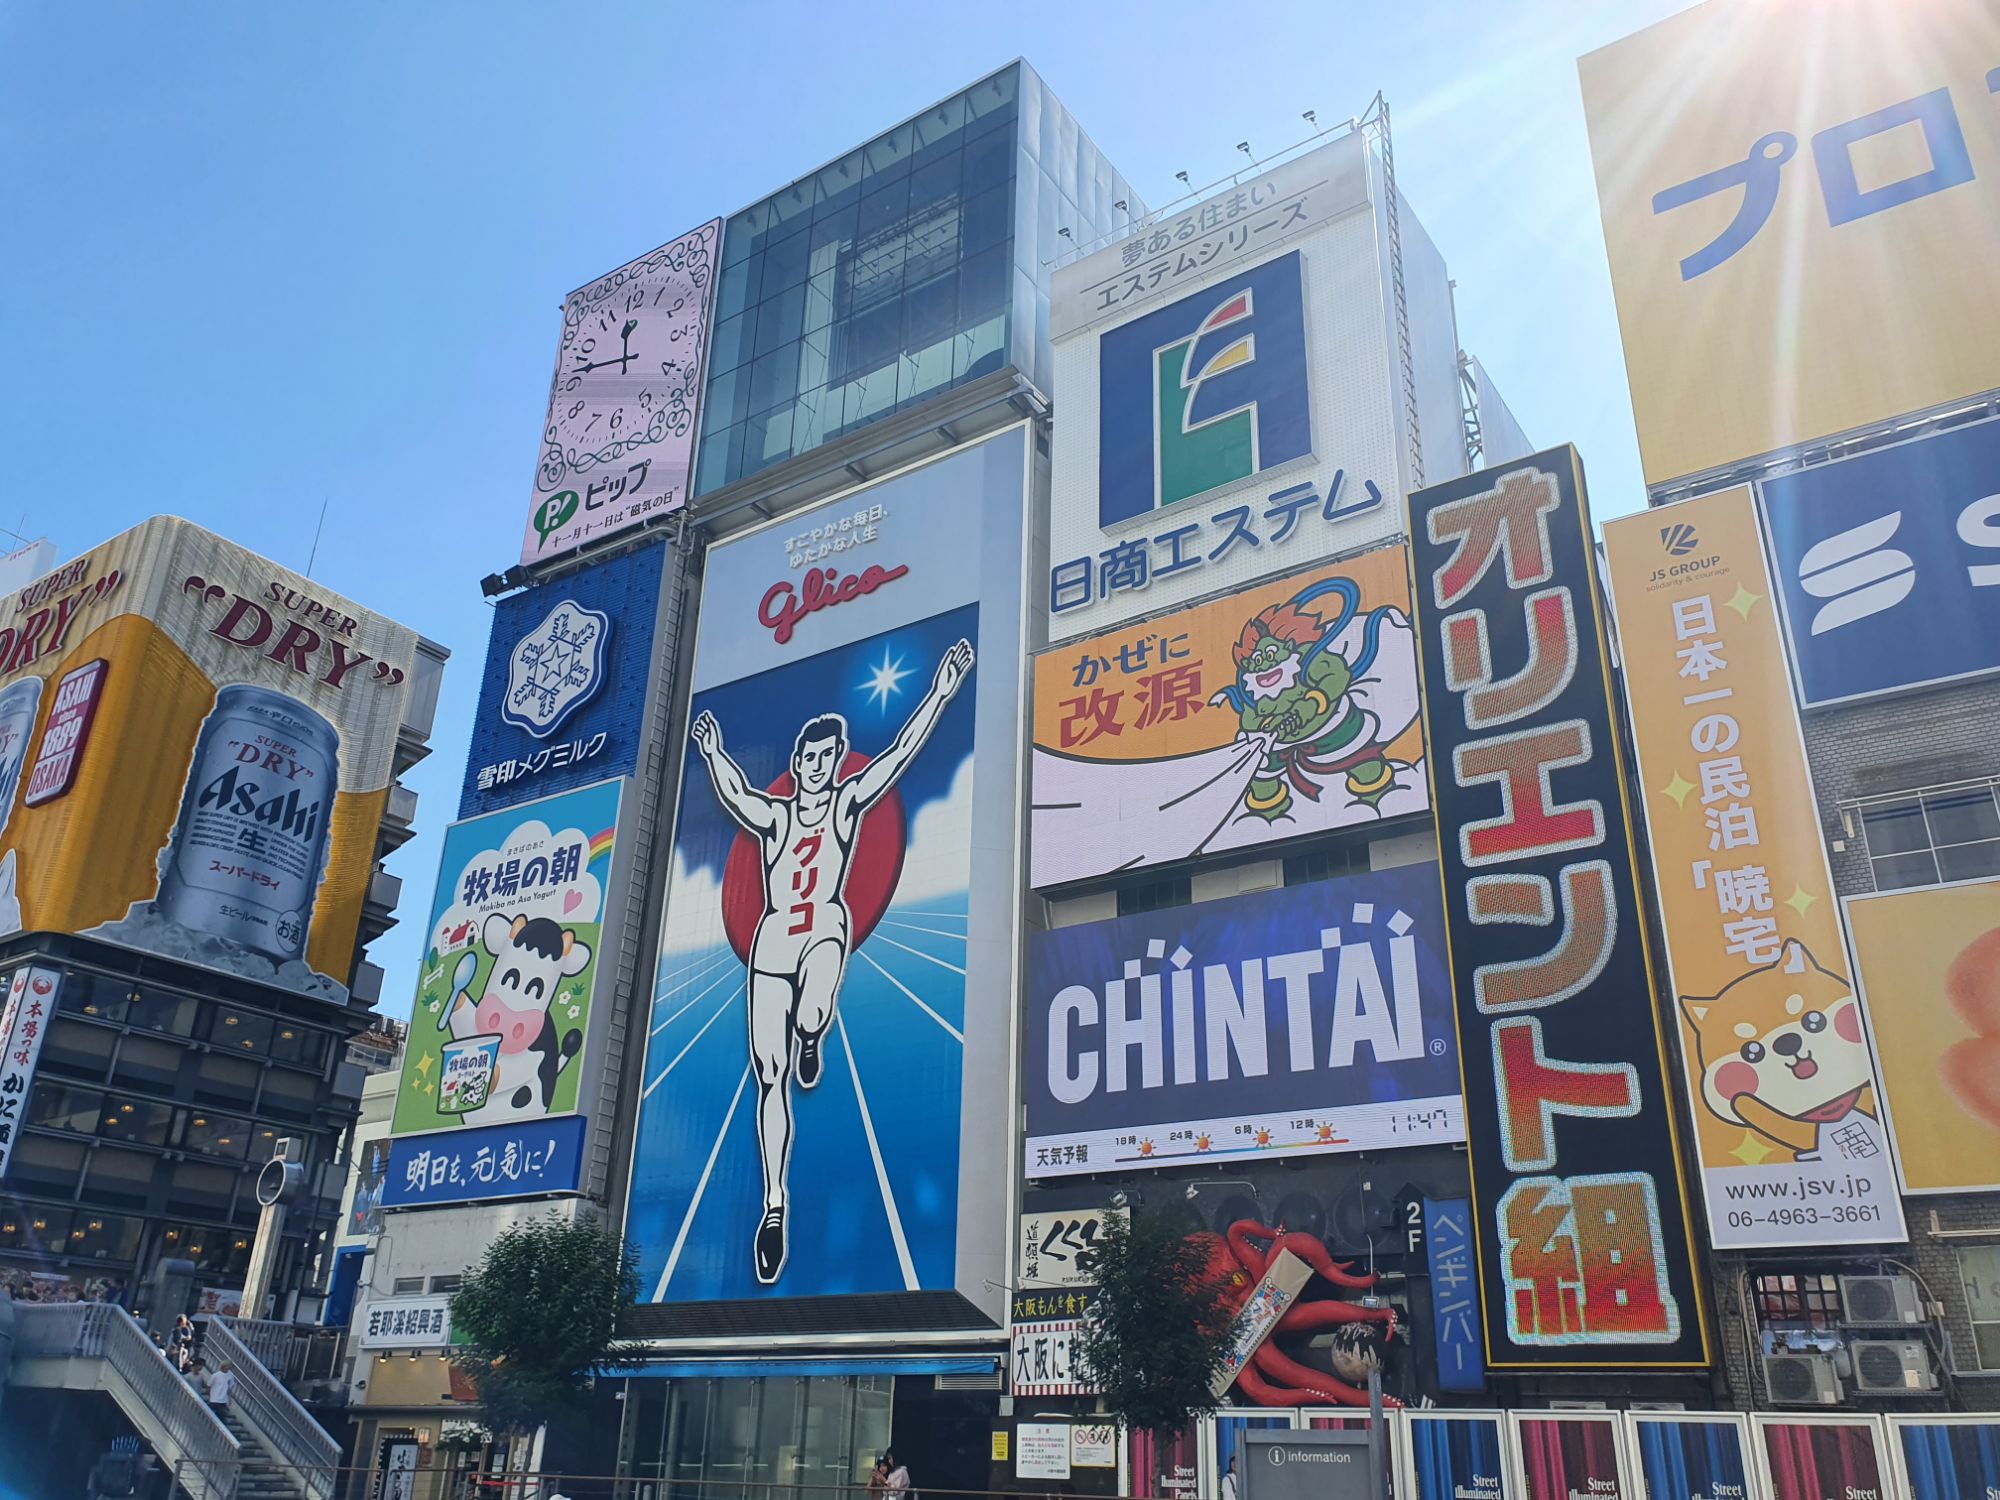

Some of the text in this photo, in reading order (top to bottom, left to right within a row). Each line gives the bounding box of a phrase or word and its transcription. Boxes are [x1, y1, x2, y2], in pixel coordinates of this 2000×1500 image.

[1652, 66, 2000, 281] プロ
[1121, 182, 1277, 268] 夢ある住まい
[1096, 196, 1309, 311] エステムシリーズ
[584, 458, 652, 511] ピップ
[789, 525, 879, 569] ゆたかな人生
[1050, 468, 1383, 615] 日商エステム
[15, 559, 86, 614] SUPER
[1646, 579, 1683, 592] solidarity
[1695, 567, 1730, 580] courage
[1649, 555, 1721, 582] JS GROUP
[264, 582, 358, 637] SUPER
[758, 564, 909, 644] Glico
[1071, 632, 1190, 688] かぜに
[52, 670, 98, 716] ASAHI
[1058, 658, 1209, 749] 改源
[40, 716, 83, 760] 1889
[255, 735, 297, 758] SUPER
[28, 753, 71, 797] OSAKA
[476, 732, 607, 791] 雪印メグミルク
[198, 765, 320, 842] Asahi
[237, 828, 268, 855] 生
[506, 840, 545, 857] まきばのあさ
[209, 860, 280, 890] スーパードライ
[463, 842, 582, 907] 牧場の朝
[787, 827, 825, 936] グリコ
[478, 888, 557, 914] Makiba no Asa Yogurt
[1426, 466, 1681, 1346] オリエント組
[449, 1053, 489, 1072] 牧場の朝
[1115, 1135, 1137, 1146] 18時
[1169, 1130, 1193, 1141] 24時
[1234, 1124, 1253, 1135] 6時
[1290, 1118, 1314, 1129] 12時
[1036, 1144, 1088, 1167] 天気予報
[1725, 1174, 1872, 1200] www.jsv.jp
[1728, 1205, 1881, 1229] 06-4963-3661
[1025, 1220, 1039, 1278] 道頓堀
[1433, 1214, 1475, 1371] ペンギンバー
[1174, 1464, 1195, 1476] Street
[1288, 1451, 1351, 1464] information
[1472, 1474, 1499, 1488] Street
[1587, 1477, 1616, 1491] Street
[1712, 1481, 1742, 1496] Street
[1845, 1485, 1877, 1500] Street
